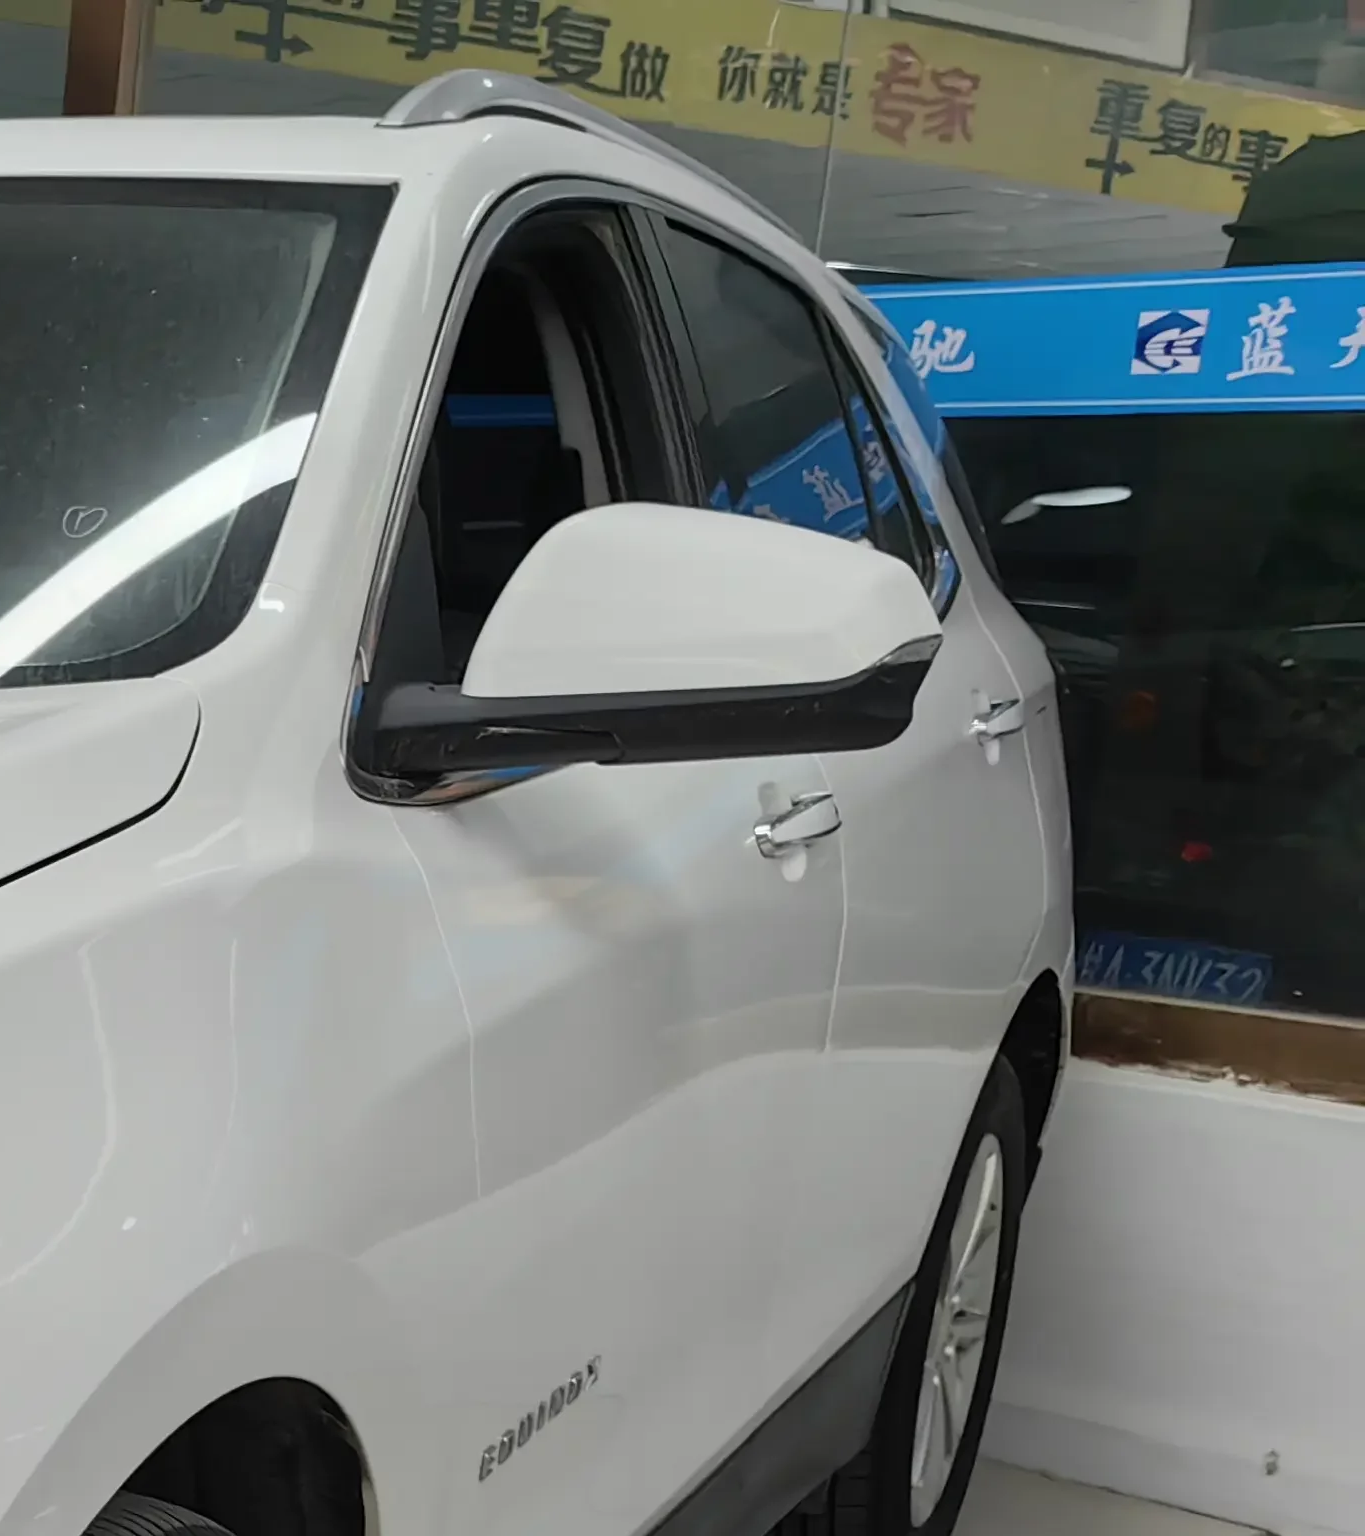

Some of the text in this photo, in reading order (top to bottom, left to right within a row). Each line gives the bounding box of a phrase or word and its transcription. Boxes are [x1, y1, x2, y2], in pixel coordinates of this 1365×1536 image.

[718, 43, 981, 147] 你就是专家
[478, 1354, 602, 1483] EQUINOX
